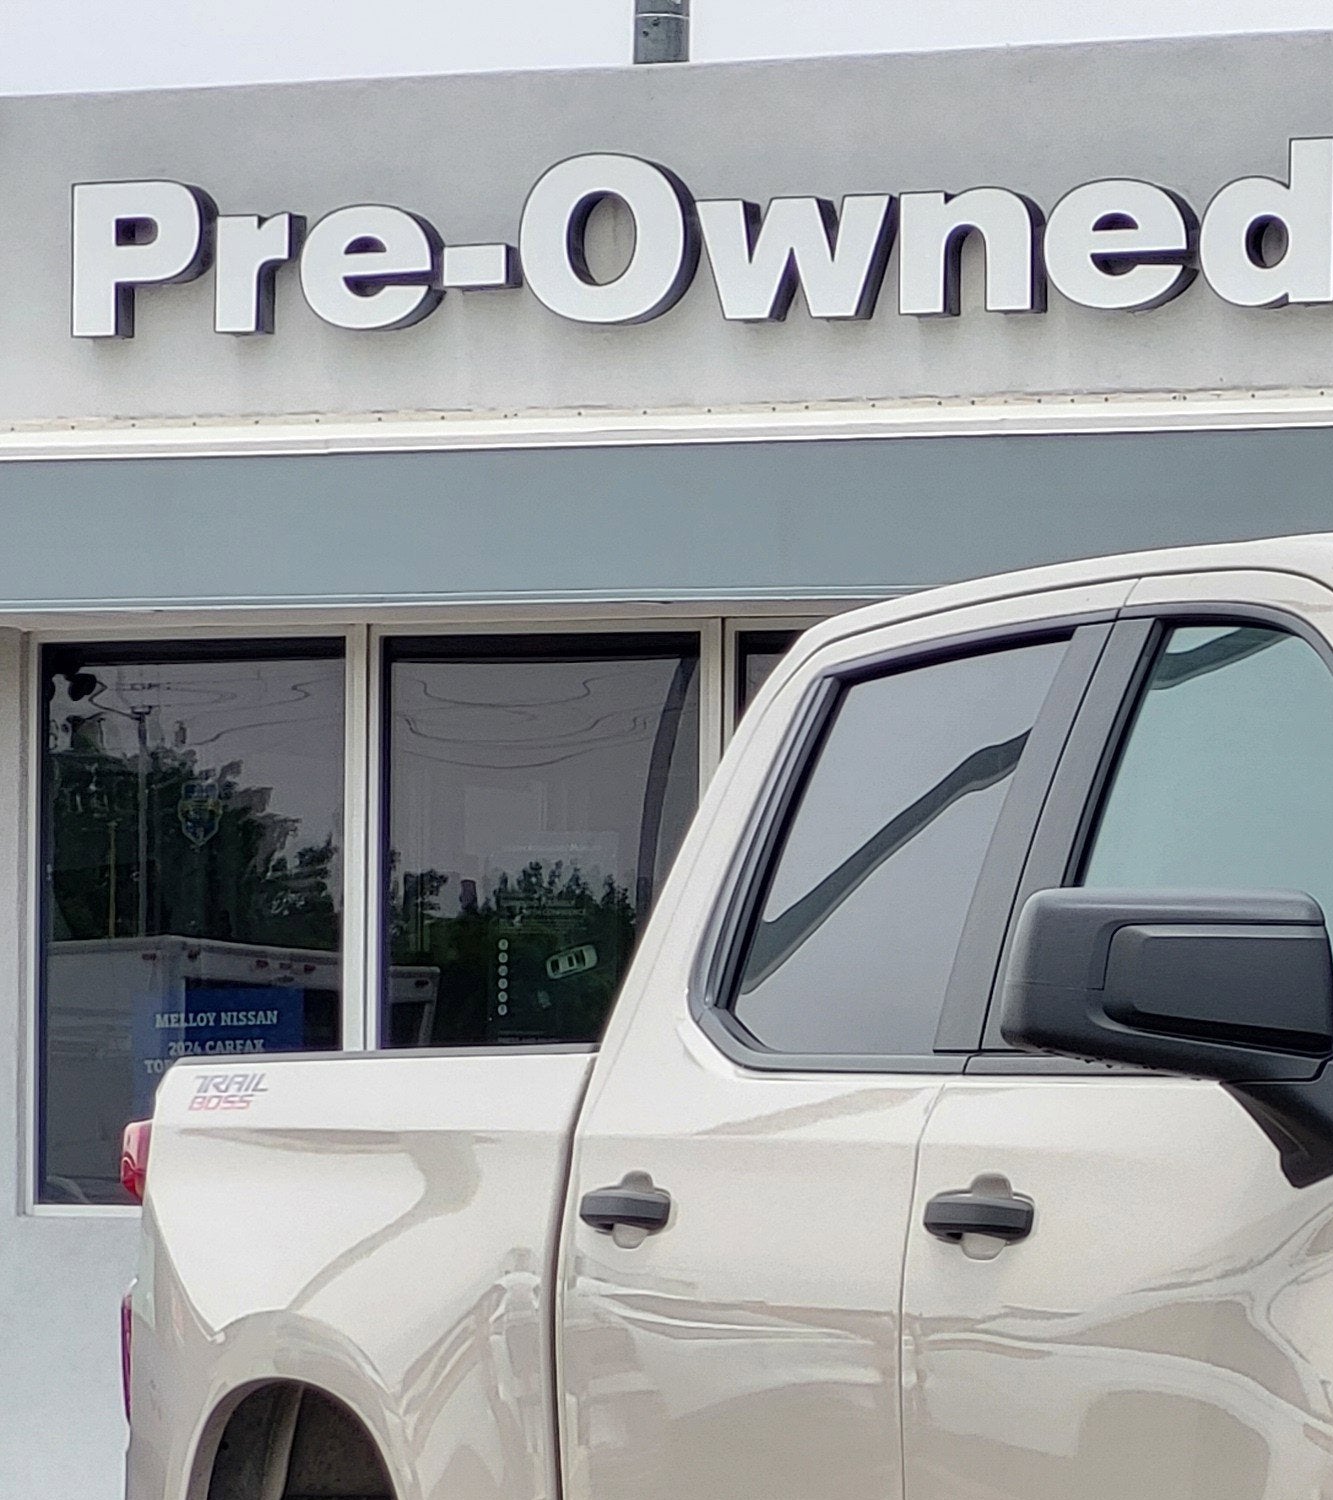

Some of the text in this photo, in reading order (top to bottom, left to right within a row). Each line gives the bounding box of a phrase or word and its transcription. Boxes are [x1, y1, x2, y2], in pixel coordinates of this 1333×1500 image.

[155, 1010, 278, 1028] MELLOY NISSAN
[205, 1039, 264, 1054] CARFAX
[195, 1073, 268, 1093] TRAIL
[188, 1094, 254, 1111] BOSS
